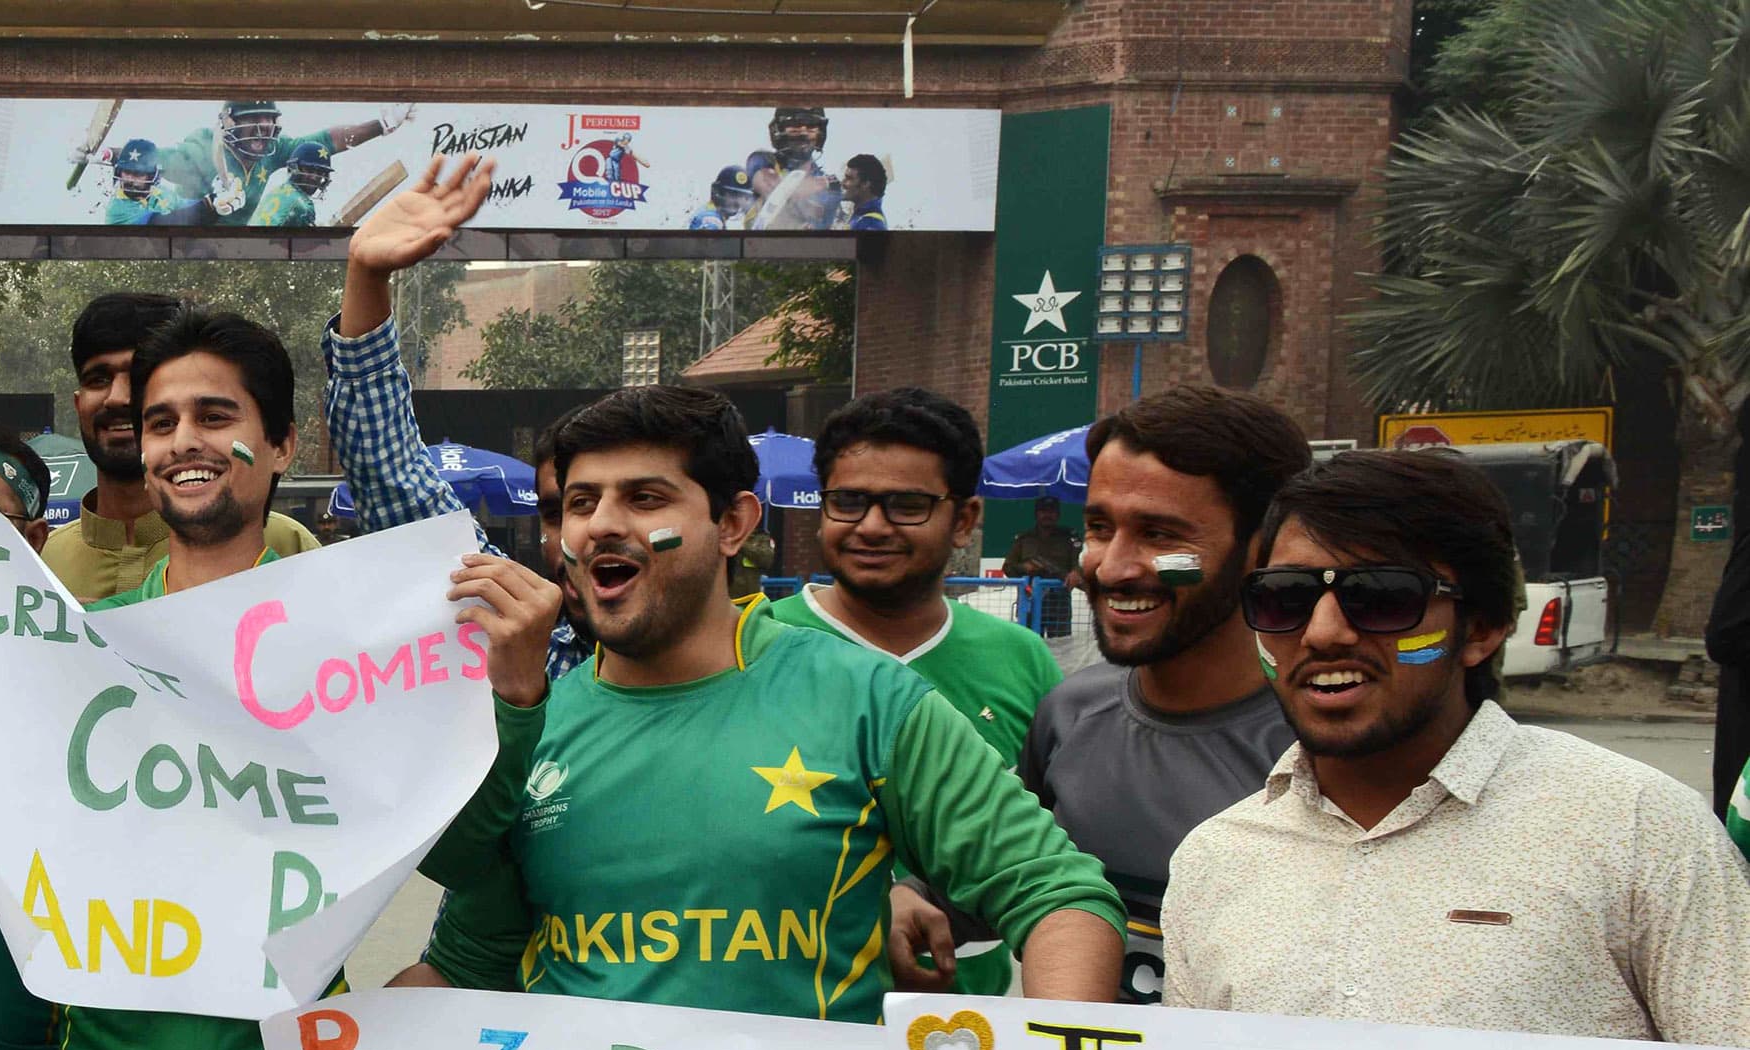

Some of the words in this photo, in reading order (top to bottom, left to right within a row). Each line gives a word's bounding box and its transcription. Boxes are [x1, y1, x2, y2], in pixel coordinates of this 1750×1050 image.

[585, 117, 637, 128] PERFUMES
[431, 122, 528, 158] PAKiSTAN
[572, 187, 607, 198] Mobile
[610, 181, 642, 200] CUP
[1010, 343, 1080, 372] PCB
[999, 378, 1032, 387] Pakistan
[1033, 376, 1062, 386] Cricket
[1063, 376, 1088, 385] Board
[792, 491, 821, 505] Hai
[234, 599, 489, 731] COMES
[67, 685, 340, 826] COME
[522, 802, 570, 822] CHAMPIONS
[530, 815, 559, 830] TROPHY
[22, 848, 203, 978] AND
[263, 850, 339, 990] P
